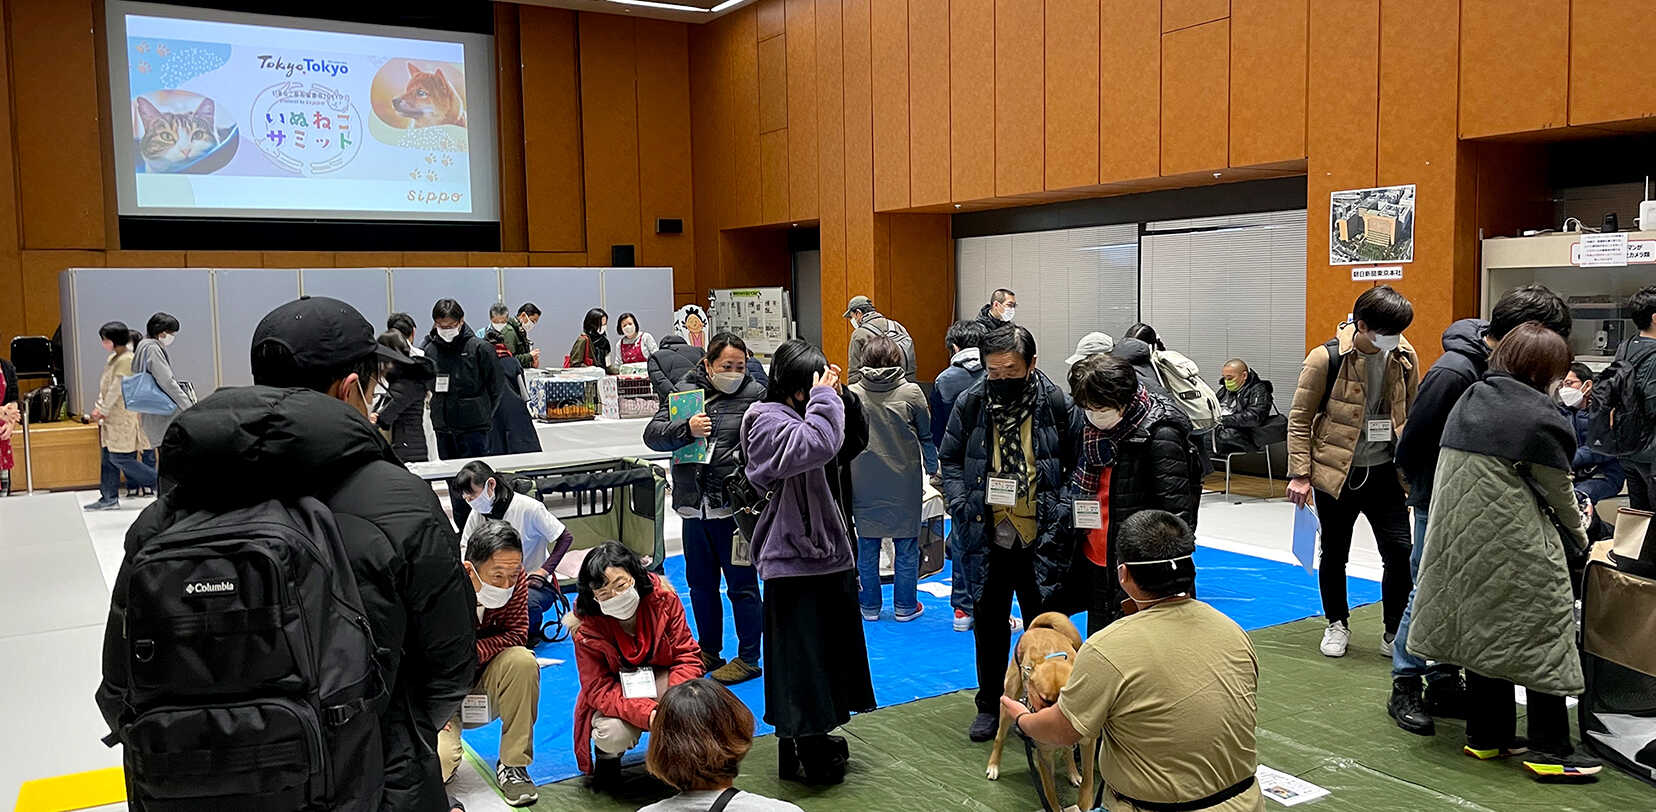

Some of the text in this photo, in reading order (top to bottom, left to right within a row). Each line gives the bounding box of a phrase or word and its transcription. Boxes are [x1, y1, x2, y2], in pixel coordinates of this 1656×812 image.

[257, 55, 349, 78] Tokyo Tokyo
[265, 111, 350, 130] いぬねこ
[266, 130, 352, 150] サミット
[194, 581, 234, 593] Columbia
